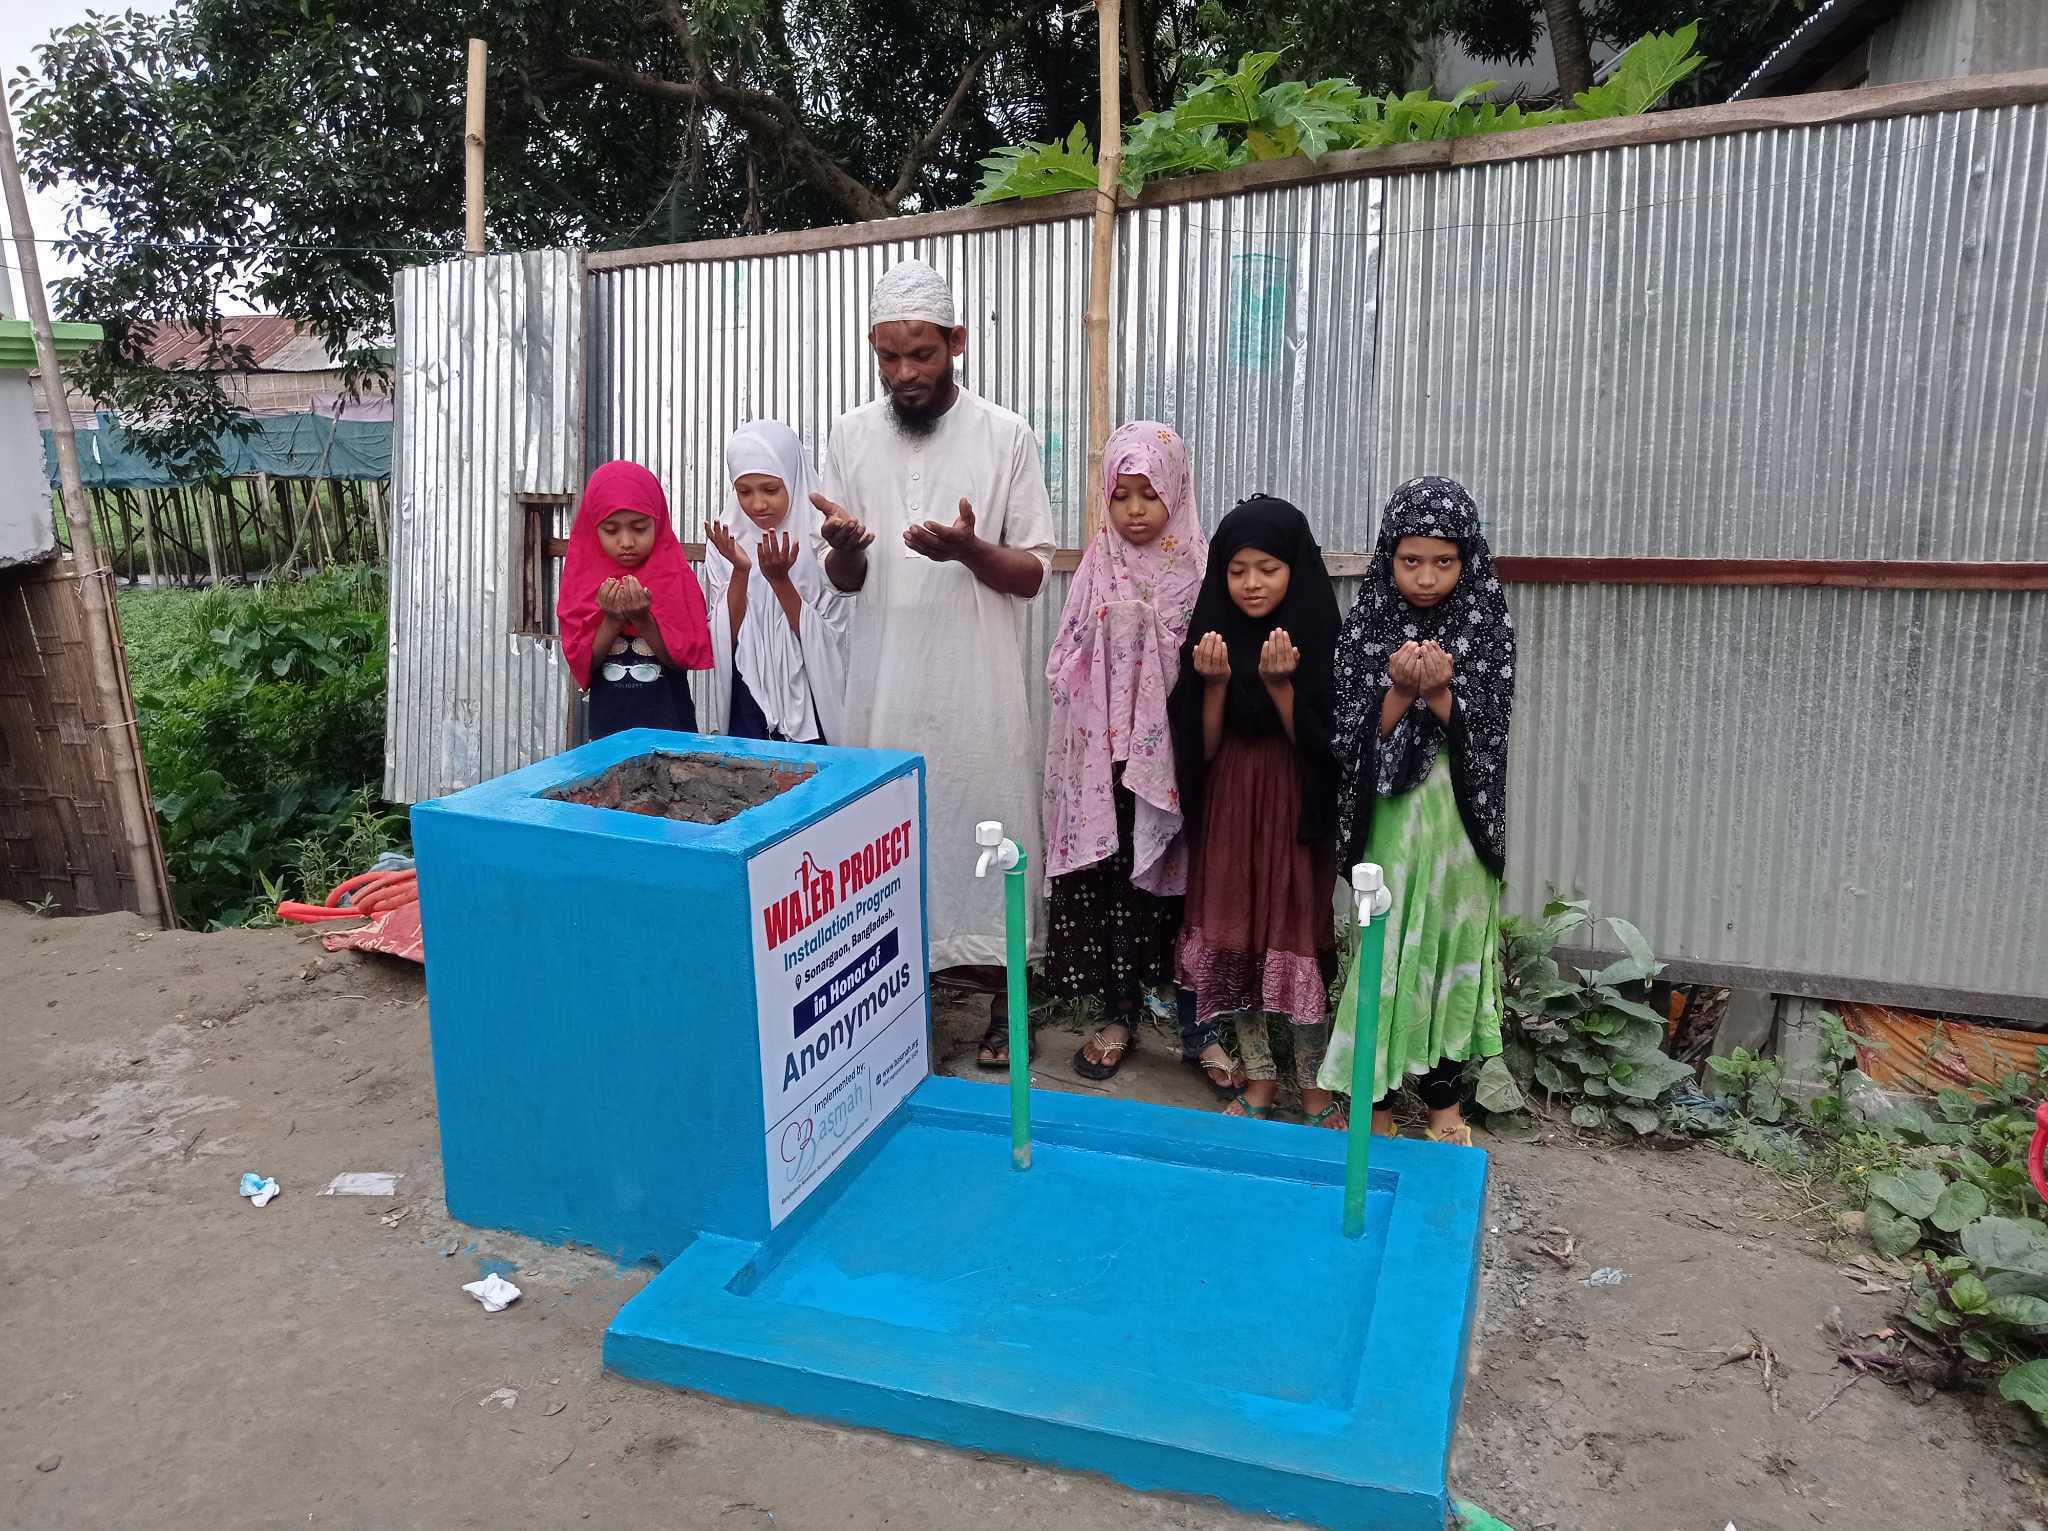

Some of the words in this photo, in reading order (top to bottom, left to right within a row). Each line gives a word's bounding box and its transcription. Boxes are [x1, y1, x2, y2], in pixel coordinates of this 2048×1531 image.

[764, 860, 835, 951] WATER
[839, 820, 911, 903] PROJECT
[784, 912, 854, 971] Installation
[856, 877, 901, 920] Program
[804, 943, 850, 983] Sonargaon,
[852, 907, 895, 947] Bangladesh.
[814, 994, 827, 1017] in
[830, 966, 866, 1005] Honor
[868, 945, 881, 972] of
[782, 962, 910, 1092] Anonymous
[814, 1070, 855, 1114] Implemented
